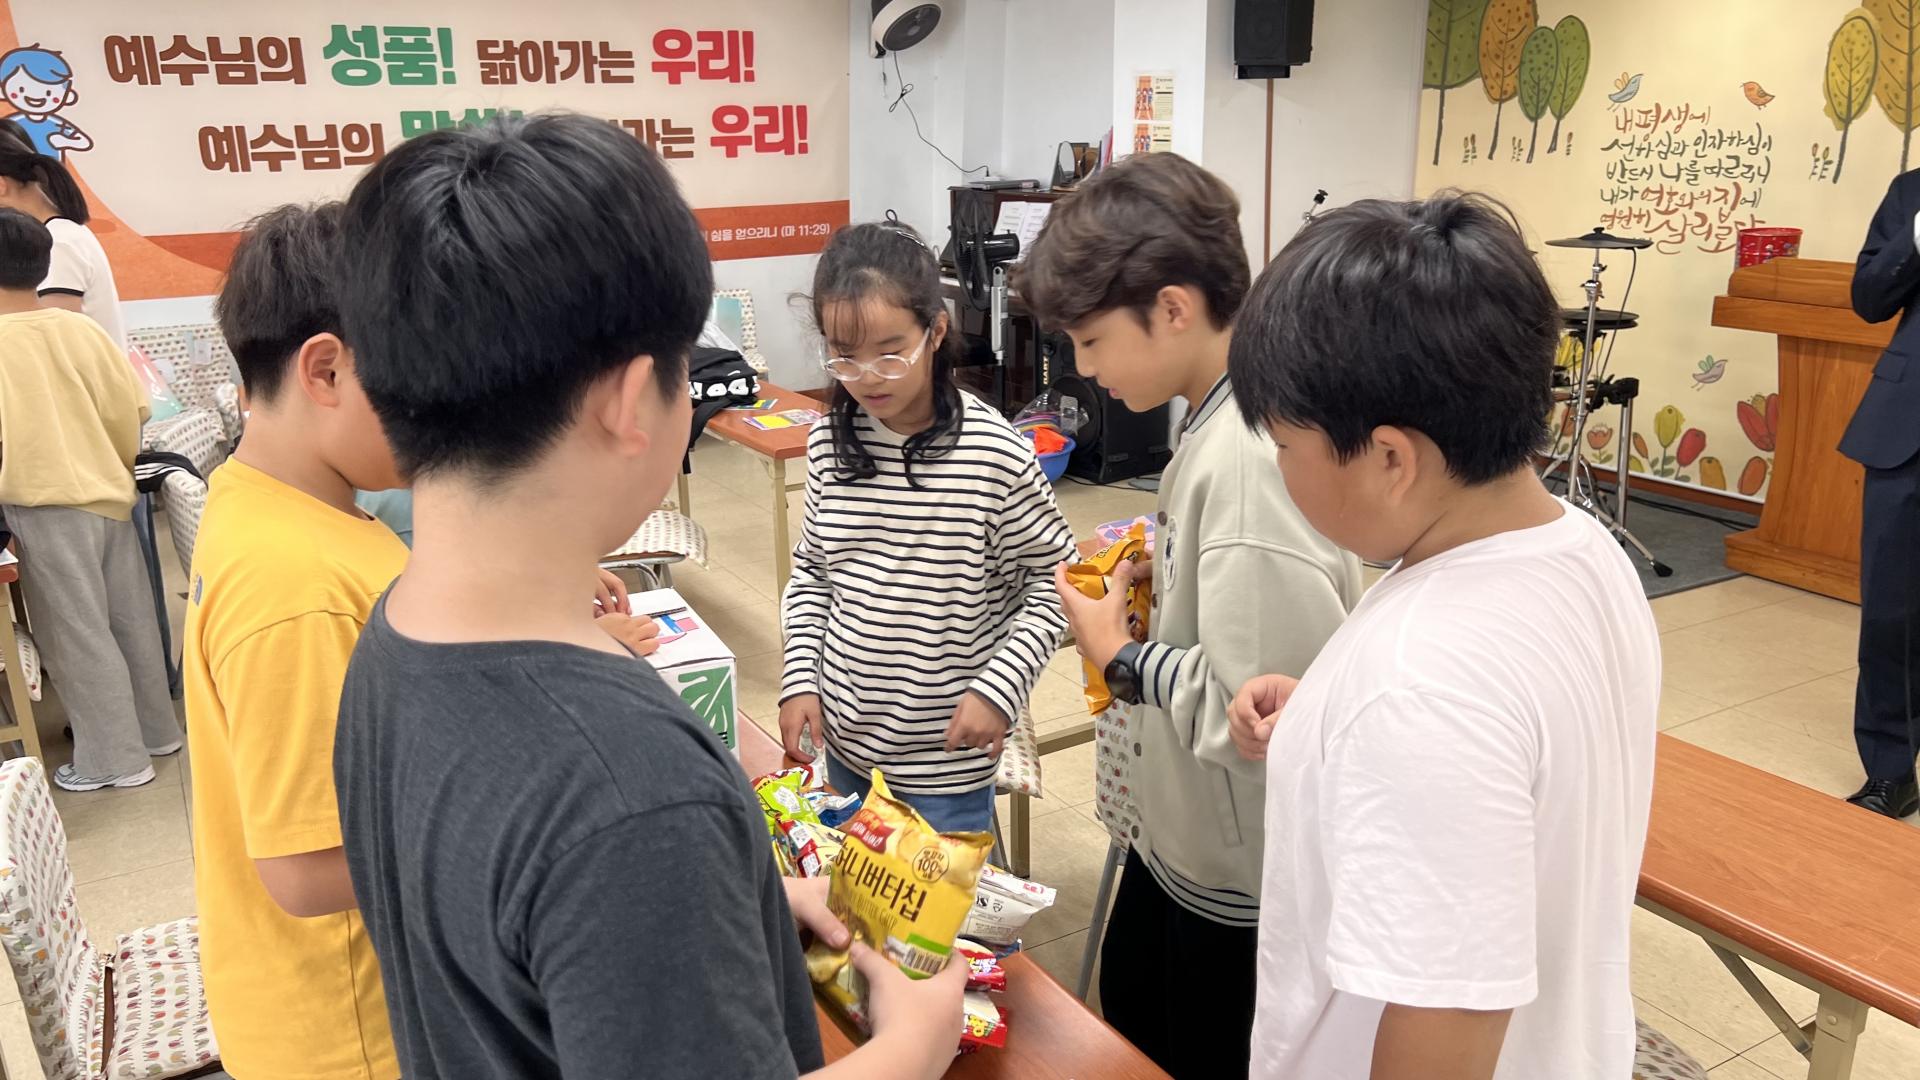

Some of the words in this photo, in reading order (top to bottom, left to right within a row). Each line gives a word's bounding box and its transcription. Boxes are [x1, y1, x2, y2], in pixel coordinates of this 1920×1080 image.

[104, 35, 306, 86] 예수님의
[323, 24, 456, 86] 성품!
[476, 39, 635, 85] 닮아가는
[651, 28, 755, 85] 우리!
[198, 123, 385, 172] 예수님의
[710, 105, 809, 158] 우리!
[1600, 131, 1689, 162] 선하심과
[1693, 122, 1772, 158] 인자하심이
[1606, 159, 1653, 184] 반드시
[1659, 160, 1701, 186] 나를
[1704, 155, 1771, 184] 따르리니
[1600, 185, 1639, 205] 내가
[711, 228, 733, 242] 쉼을
[735, 226, 778, 241] 얻으리니
[1600, 206, 1651, 230] 영원히
[835, 842, 928, 923] 허니버터칩
